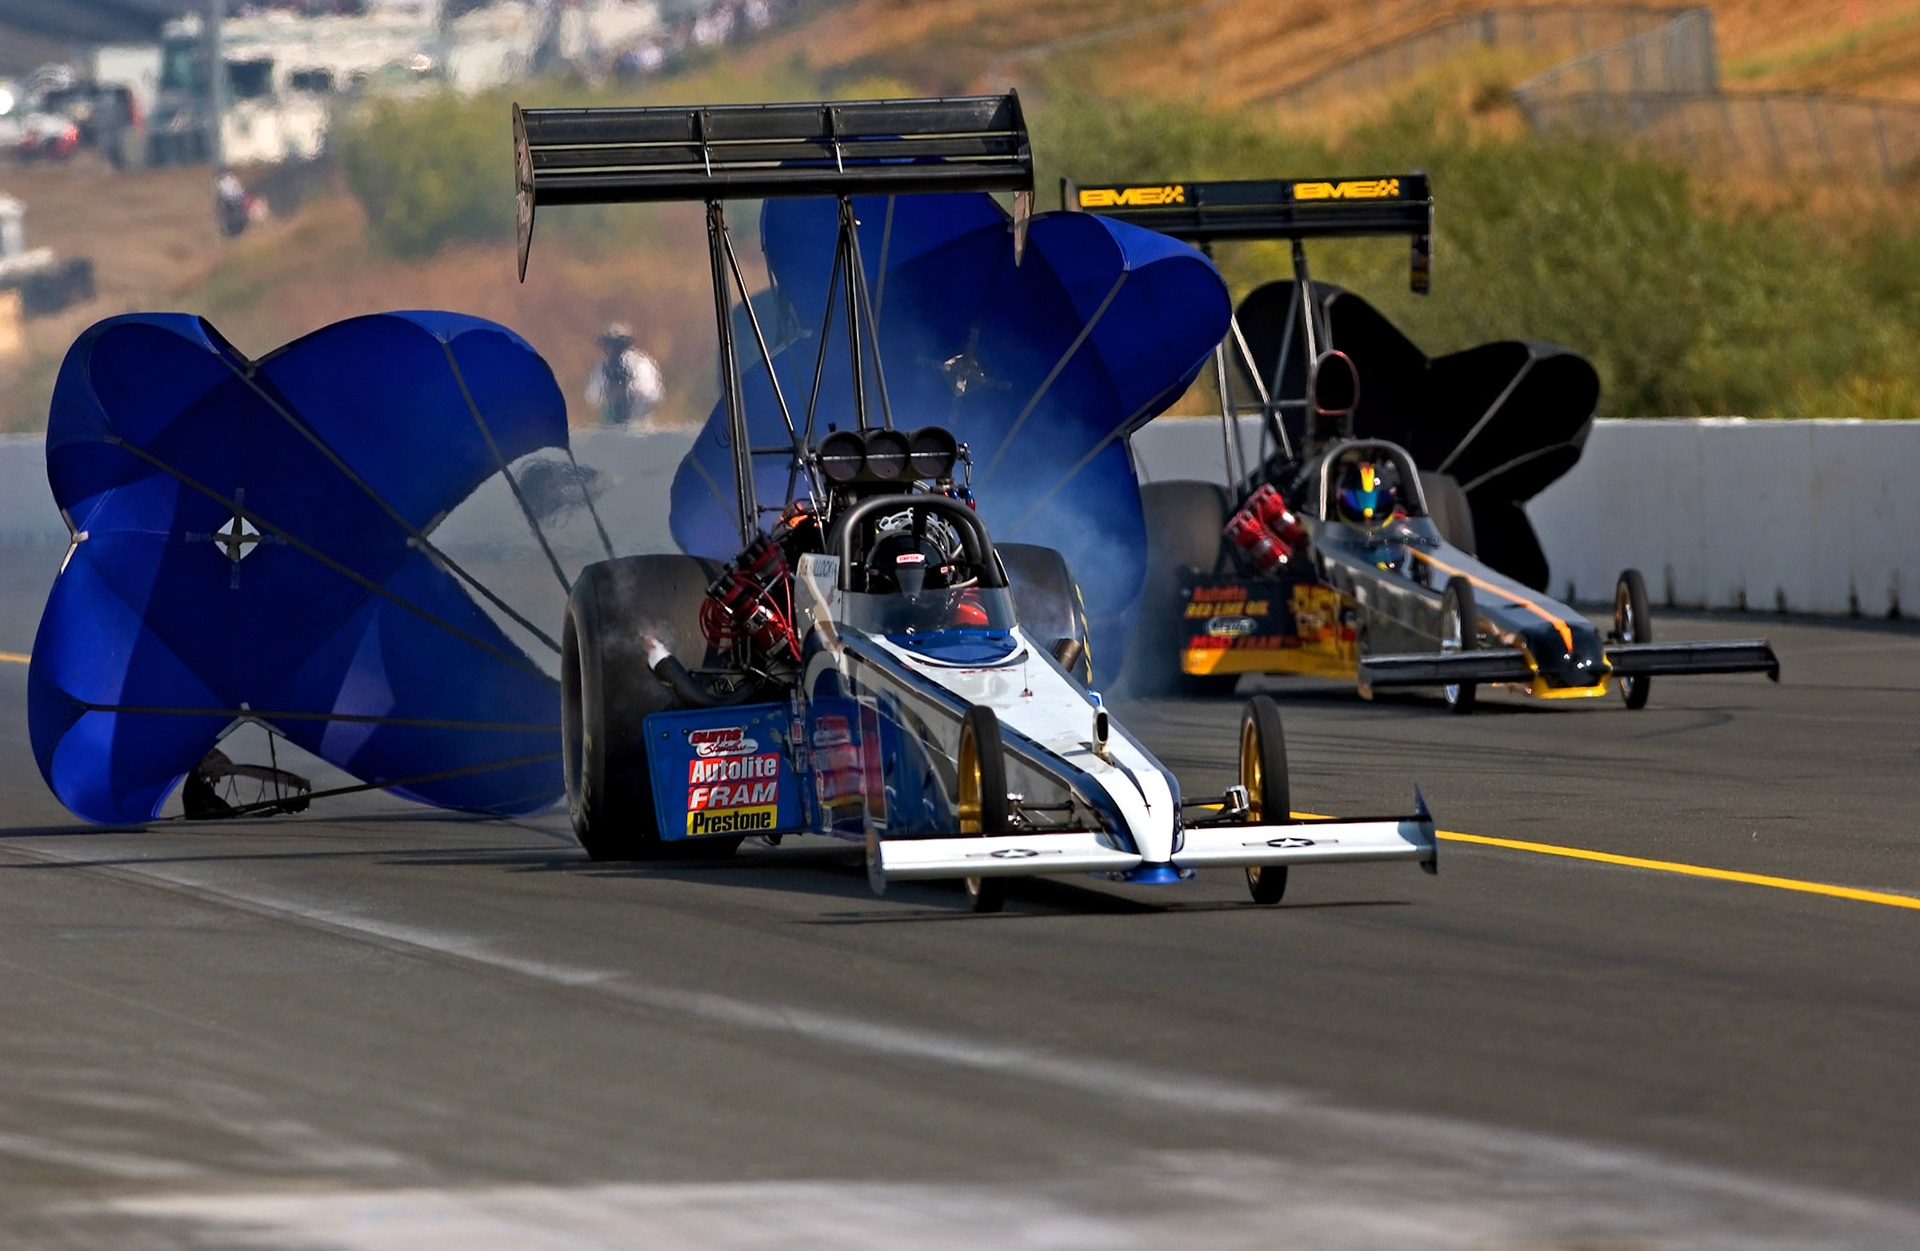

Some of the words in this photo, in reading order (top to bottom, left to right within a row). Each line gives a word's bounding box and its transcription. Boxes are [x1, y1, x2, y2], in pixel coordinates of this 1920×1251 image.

[691, 756, 777, 783] Autolite
[690, 782, 777, 809] FRAM
[692, 811, 771, 834] Prestone
